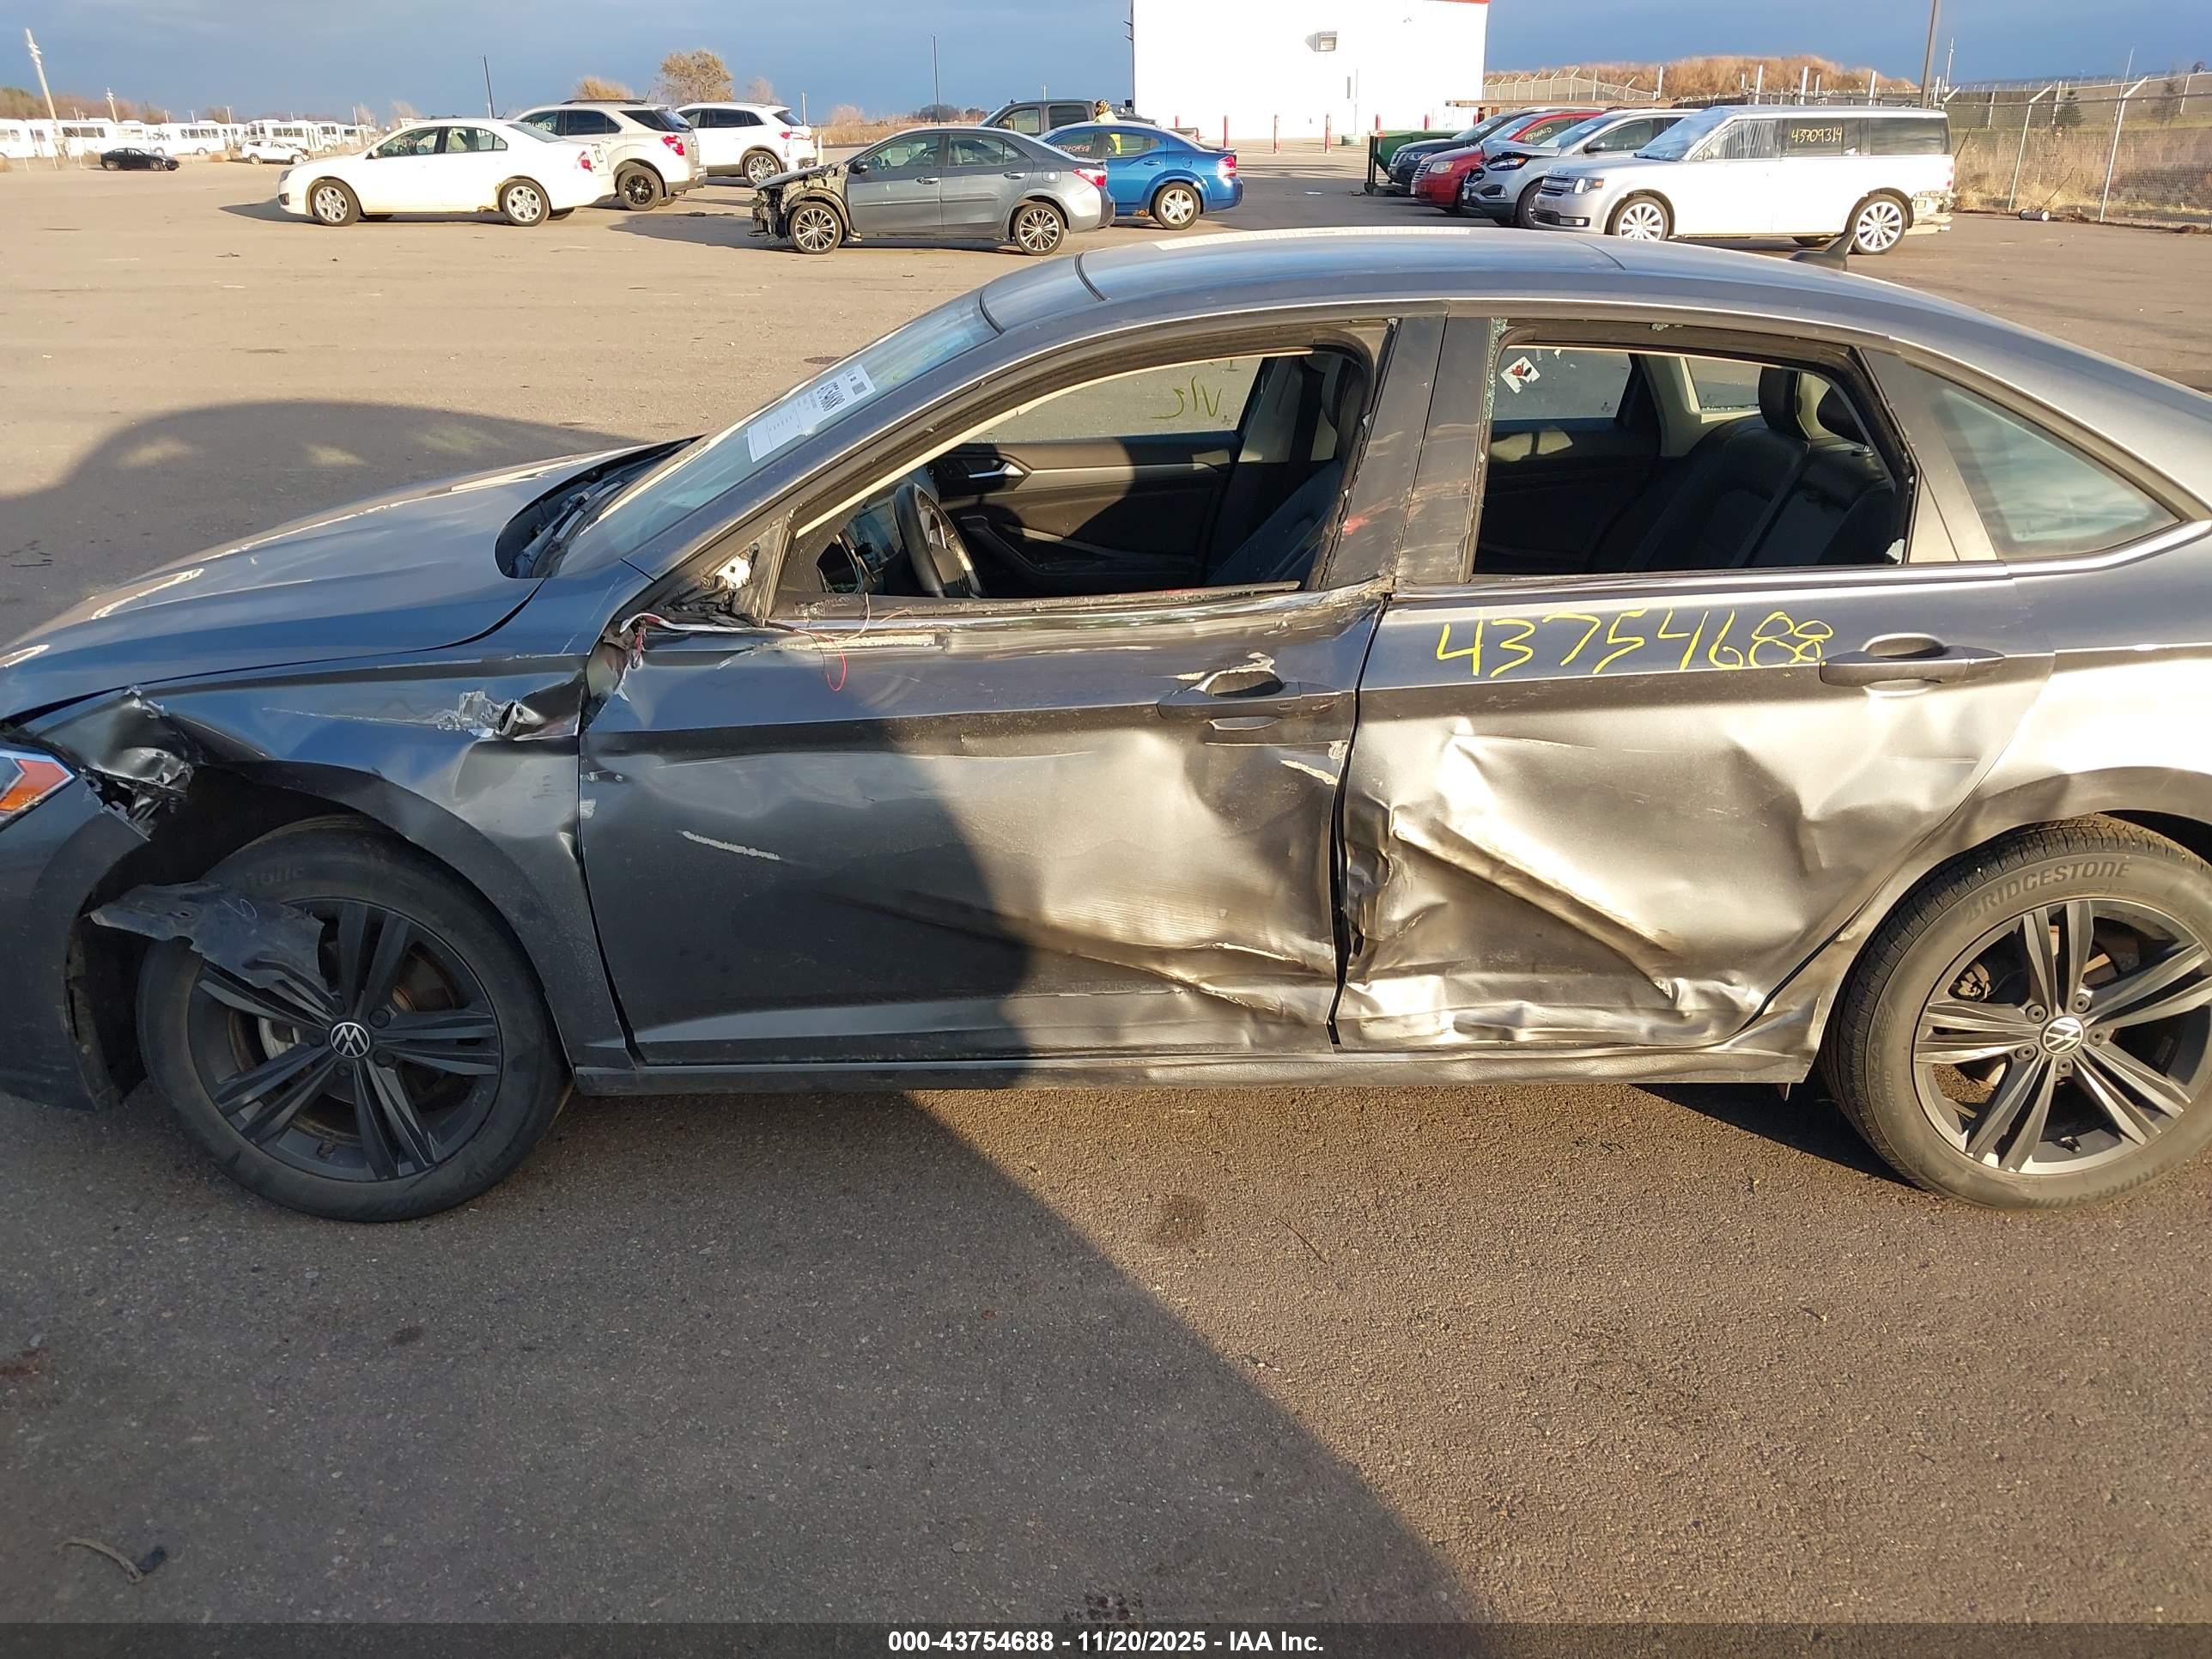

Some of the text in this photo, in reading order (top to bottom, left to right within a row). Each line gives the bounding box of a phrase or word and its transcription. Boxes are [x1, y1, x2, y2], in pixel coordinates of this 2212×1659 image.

[1791, 126, 1843, 143] 43709314
[1436, 608, 1833, 678] 43754688
[1960, 860, 2133, 925] BRIDGESTONE
